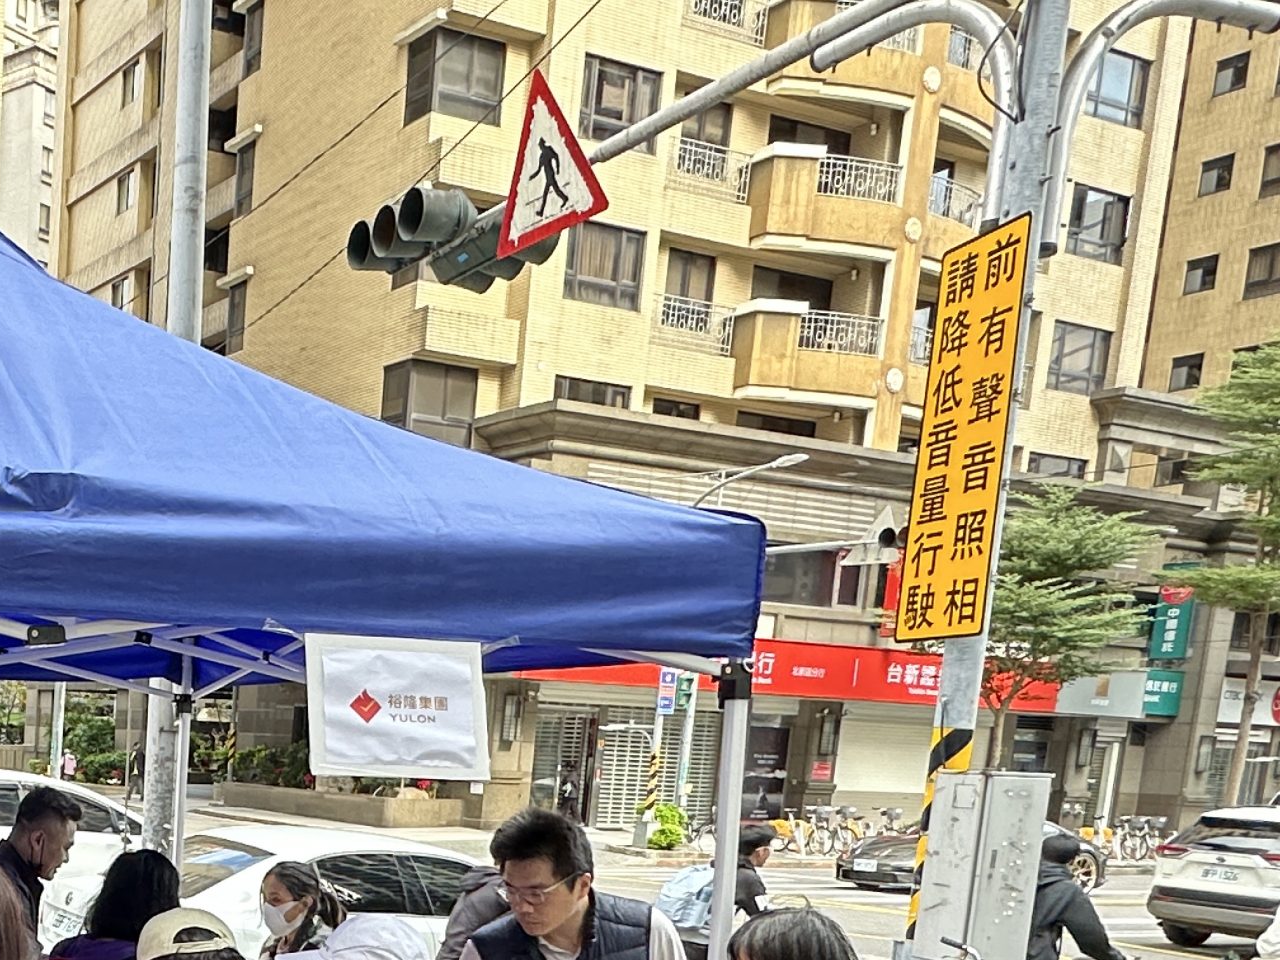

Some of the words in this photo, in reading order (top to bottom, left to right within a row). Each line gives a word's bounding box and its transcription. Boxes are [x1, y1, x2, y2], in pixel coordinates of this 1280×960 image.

[904, 252, 979, 630] 請降低音量行駛
[943, 233, 1022, 628] 前有聲音照相
[387, 694, 448, 711] 裕隆集團
[389, 713, 436, 724] YULON
